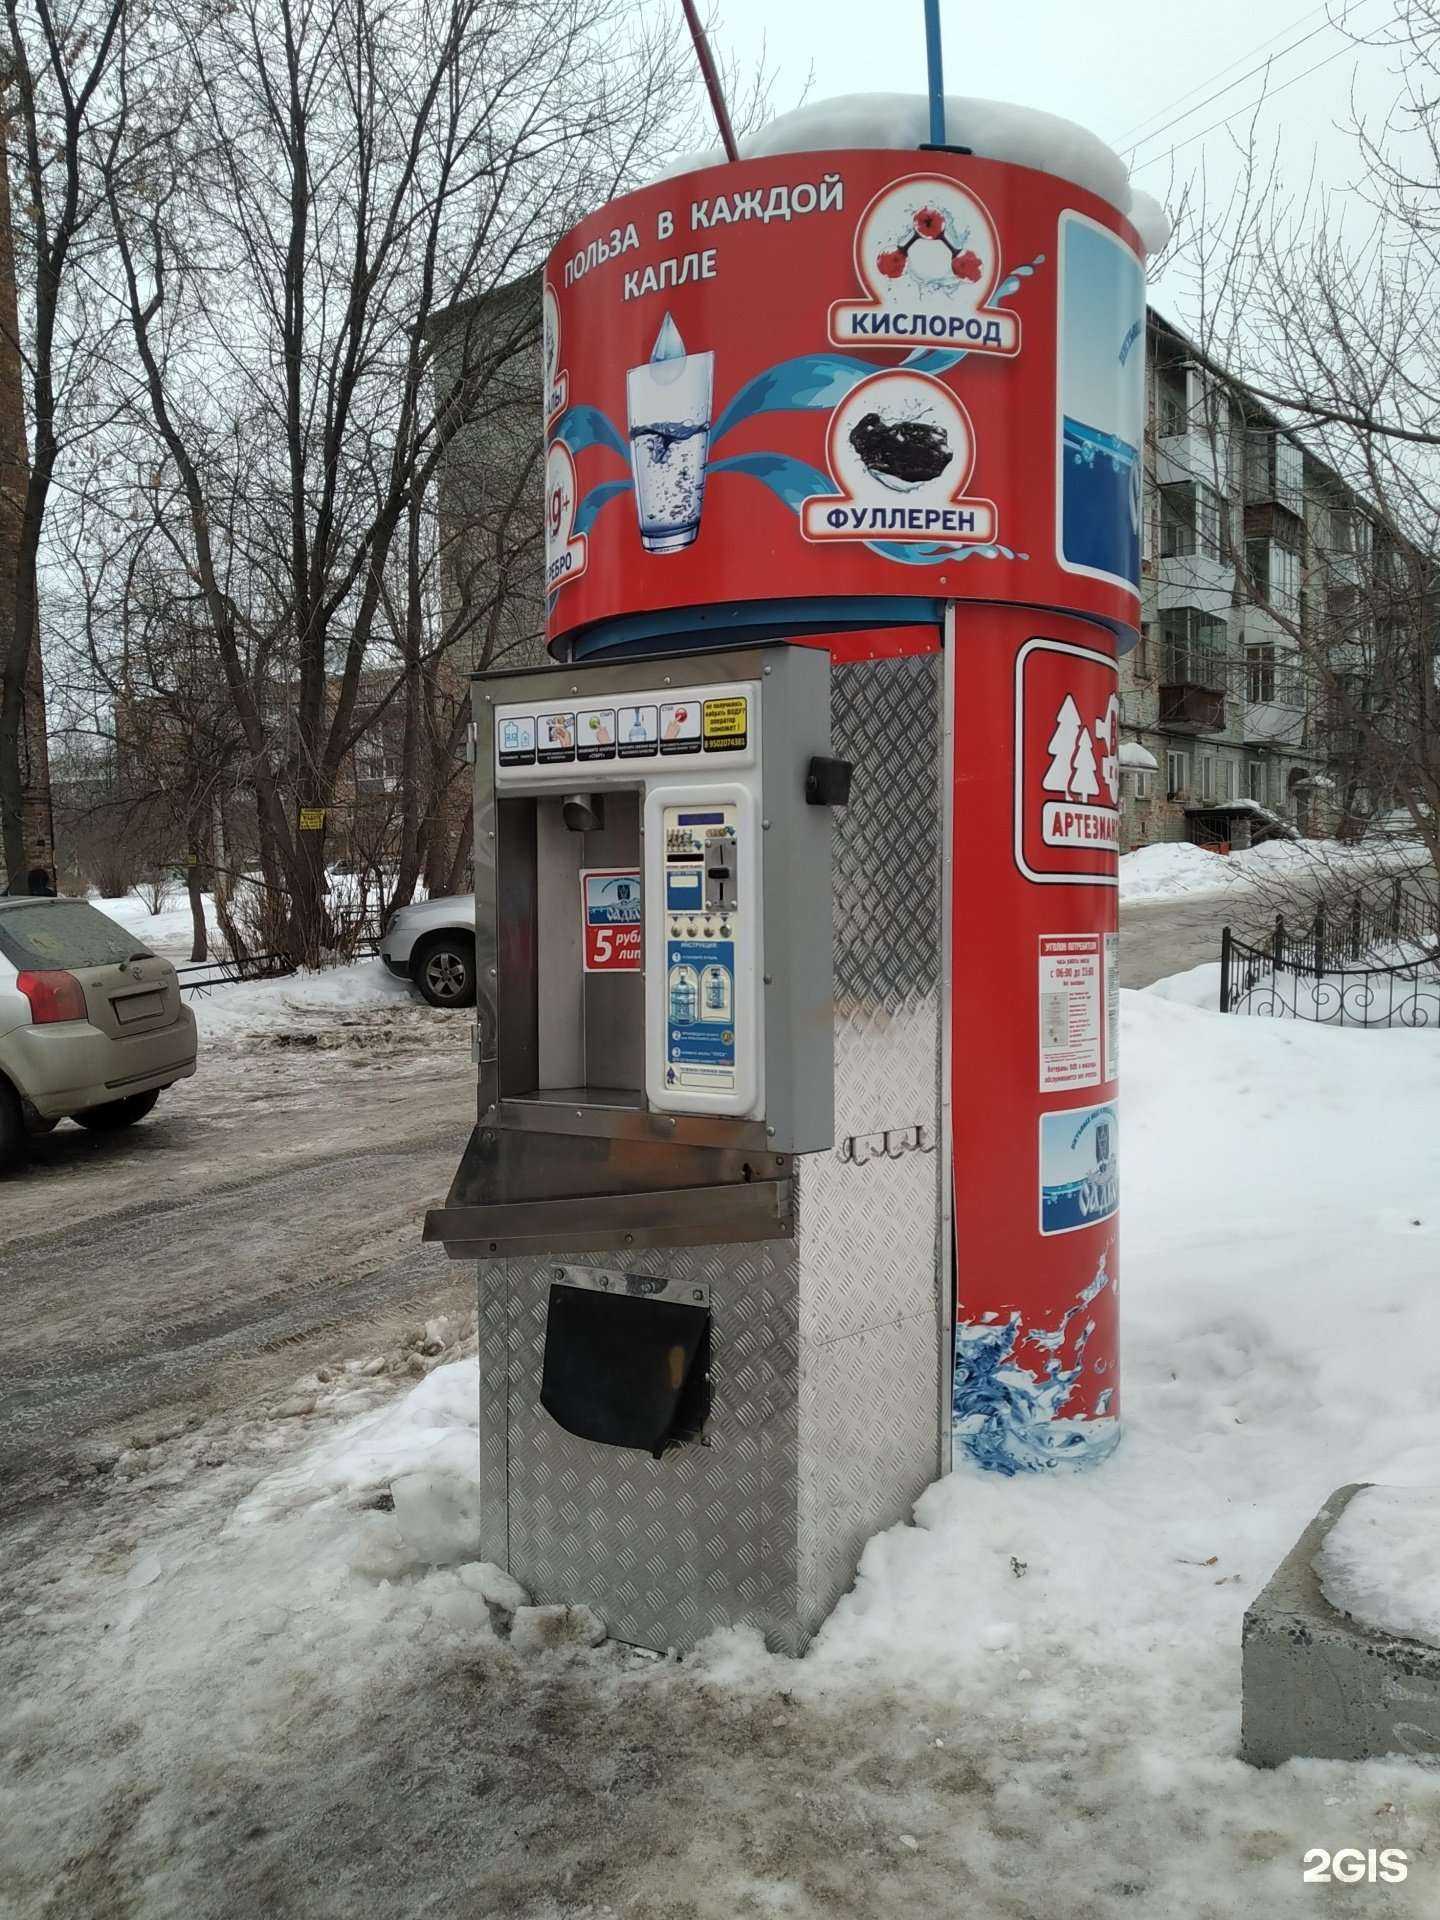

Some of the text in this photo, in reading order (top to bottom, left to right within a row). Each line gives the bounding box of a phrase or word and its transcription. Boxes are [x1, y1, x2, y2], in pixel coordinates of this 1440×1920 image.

[564, 173, 844, 288] ПОЛЬЗА В КАЖДОЙ
[623, 249, 717, 300] КАПЛЕ
[851, 312, 1002, 346] КИСЛОРОД
[826, 507, 975, 532] ФУЛЛЕРЕН
[593, 929, 613, 962] 5
